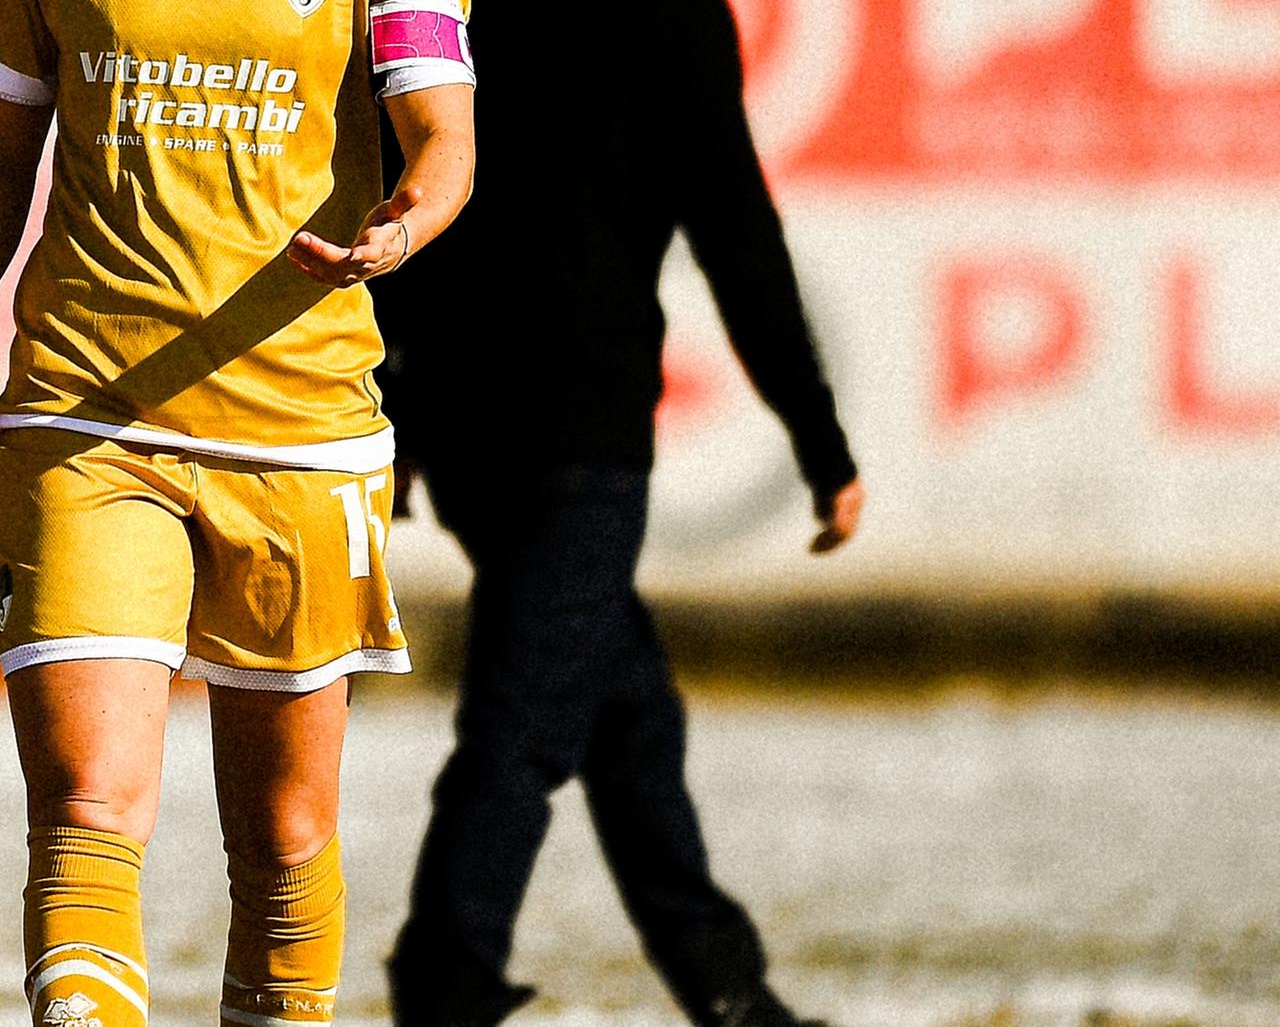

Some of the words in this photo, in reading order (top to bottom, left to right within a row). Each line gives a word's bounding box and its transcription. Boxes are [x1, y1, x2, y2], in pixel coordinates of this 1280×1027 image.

[79, 51, 298, 93] Vitobello
[119, 91, 306, 133] ricambi
[163, 137, 217, 152] SPARE
